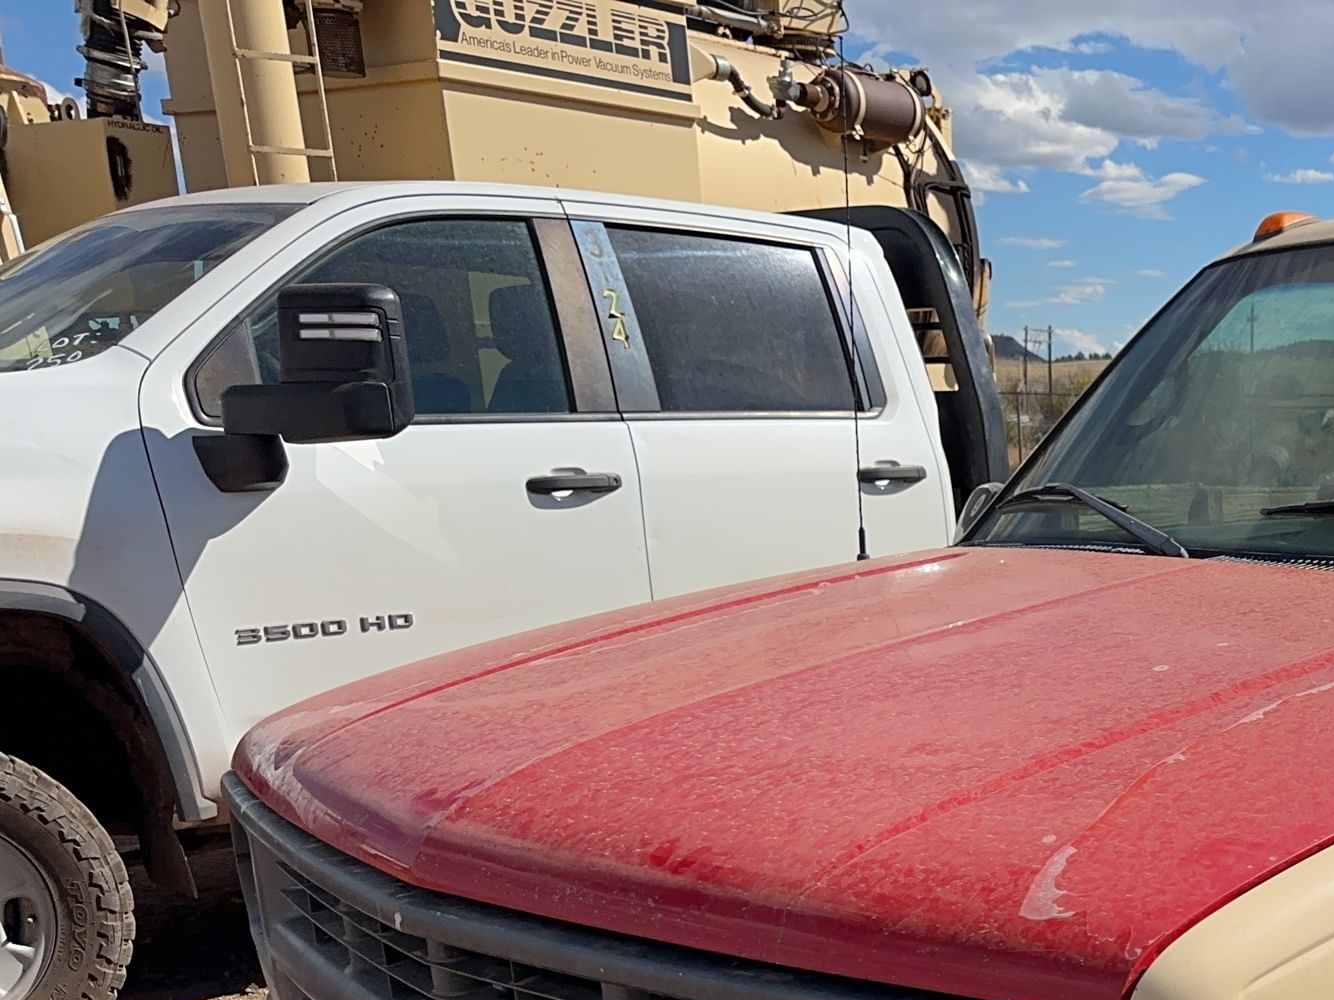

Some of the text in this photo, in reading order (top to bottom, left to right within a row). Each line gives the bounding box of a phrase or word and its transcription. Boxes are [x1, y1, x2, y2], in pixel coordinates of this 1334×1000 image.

[461, 32, 671, 82] America's Leader in Power Vacuum Systems
[234, 613, 414, 647] 3500 HD
[66, 880, 88, 972] TOYO
